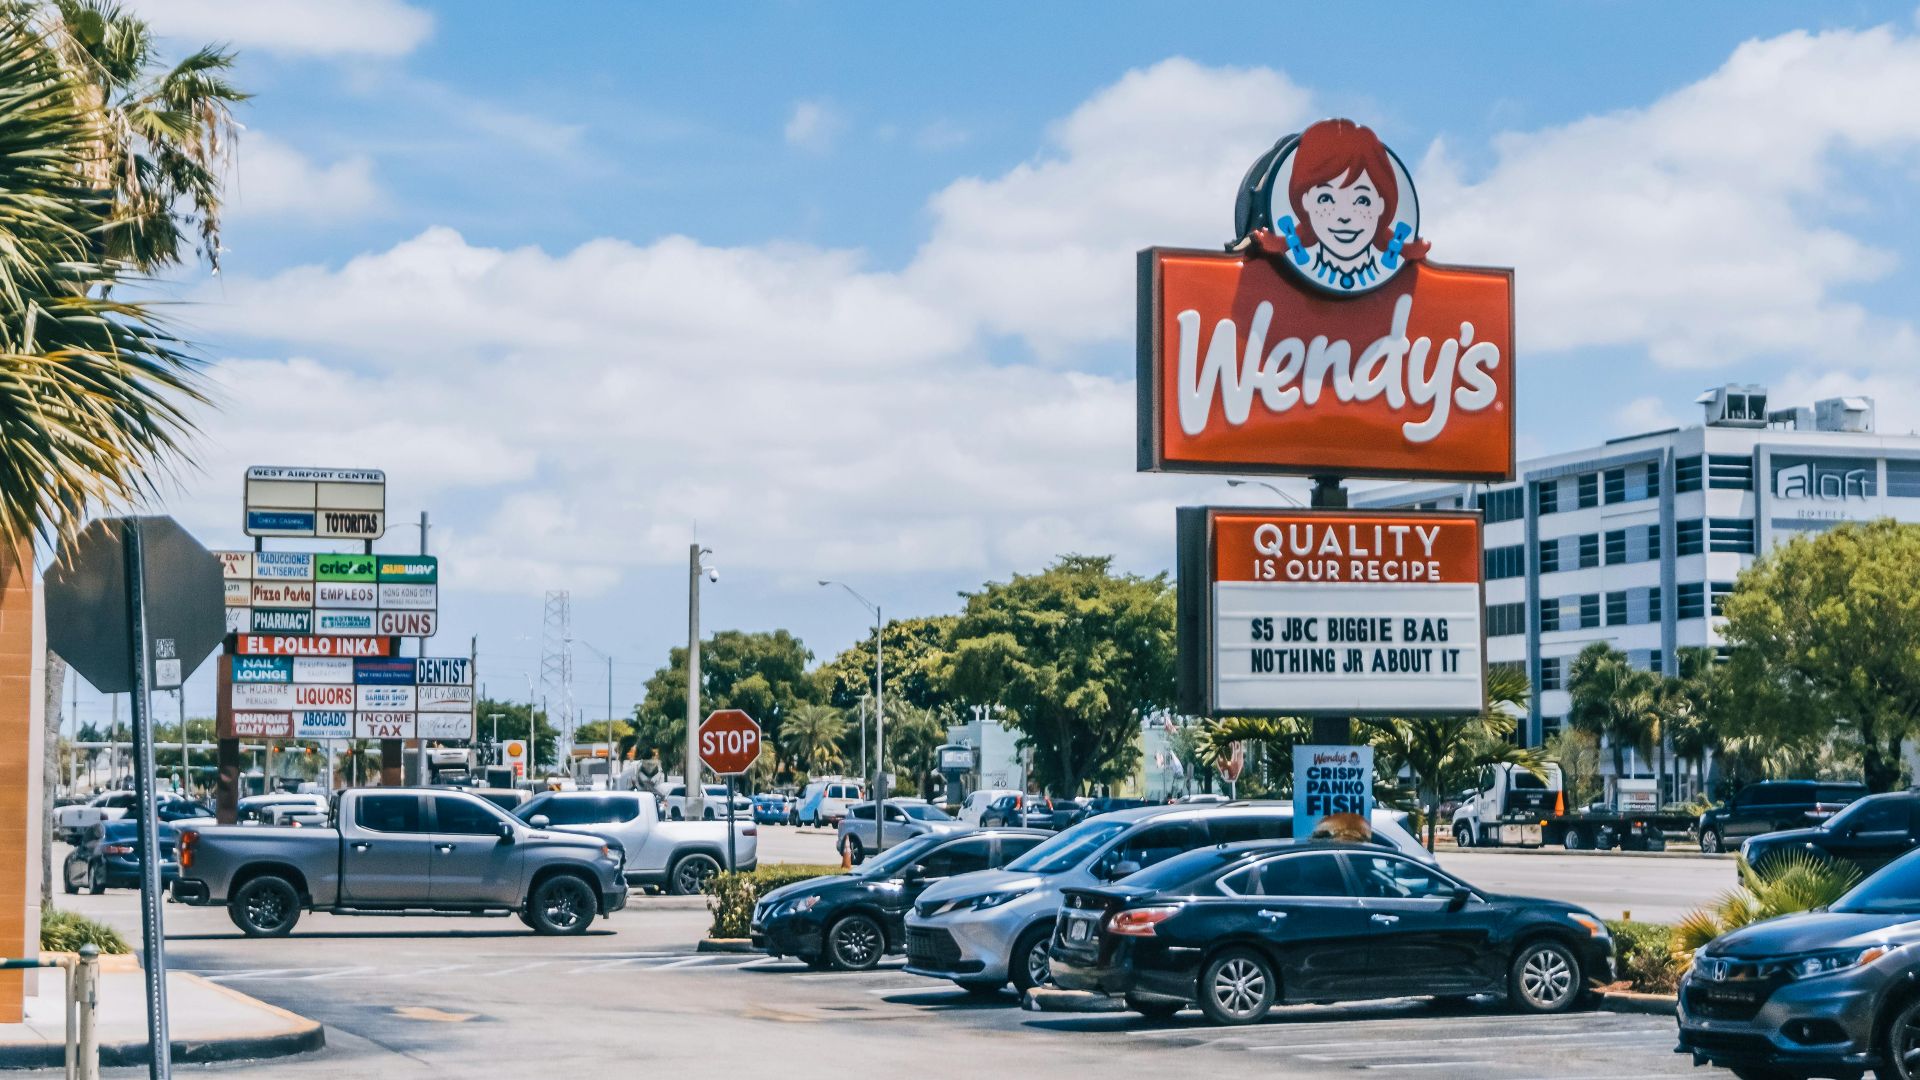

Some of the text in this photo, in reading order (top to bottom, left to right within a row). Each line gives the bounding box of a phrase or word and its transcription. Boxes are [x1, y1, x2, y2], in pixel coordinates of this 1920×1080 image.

[1177, 294, 1500, 443] Wendy's
[287, 470, 333, 478] AIRPORT
[1777, 463, 1870, 501] aloft
[325, 512, 377, 533] TOTORITAS
[1253, 523, 1441, 558] QUALITY
[256, 552, 310, 564] TRADUCCIONES
[258, 566, 309, 576] MULTISERVICE
[320, 561, 373, 574] cricket
[381, 564, 434, 574] SUBWAY
[1254, 559, 1441, 581] IS OUR RECIPE
[254, 585, 280, 600] Pizza
[284, 586, 310, 601] Pasta
[320, 588, 373, 600] EMPLEOS
[383, 588, 433, 597] HONG KONG CITY
[254, 612, 309, 629] PHARMACY
[381, 613, 431, 633] GUNS
[1251, 617, 1448, 641] $5 JBC BIGGIE BAG
[247, 636, 380, 654] EL POLLO INKA
[243, 659, 273, 668] NAIL
[1251, 648, 1460, 673] NOTHING JR ABOUT IT
[237, 670, 287, 680] LOUNGE
[419, 660, 466, 684] DENTIST
[296, 688, 352, 705] LIQUORS
[235, 713, 289, 724] BOUTIQUE
[303, 711, 347, 726] ABOGADO
[360, 713, 412, 723] INCOME
[367, 724, 402, 736] TAX
[702, 729, 756, 755] STOP
[1313, 752, 1347, 765] Wendy's
[1306, 766, 1364, 780] CRISPY
[1306, 780, 1364, 795] PANKO
[1306, 795, 1364, 816] FISH
